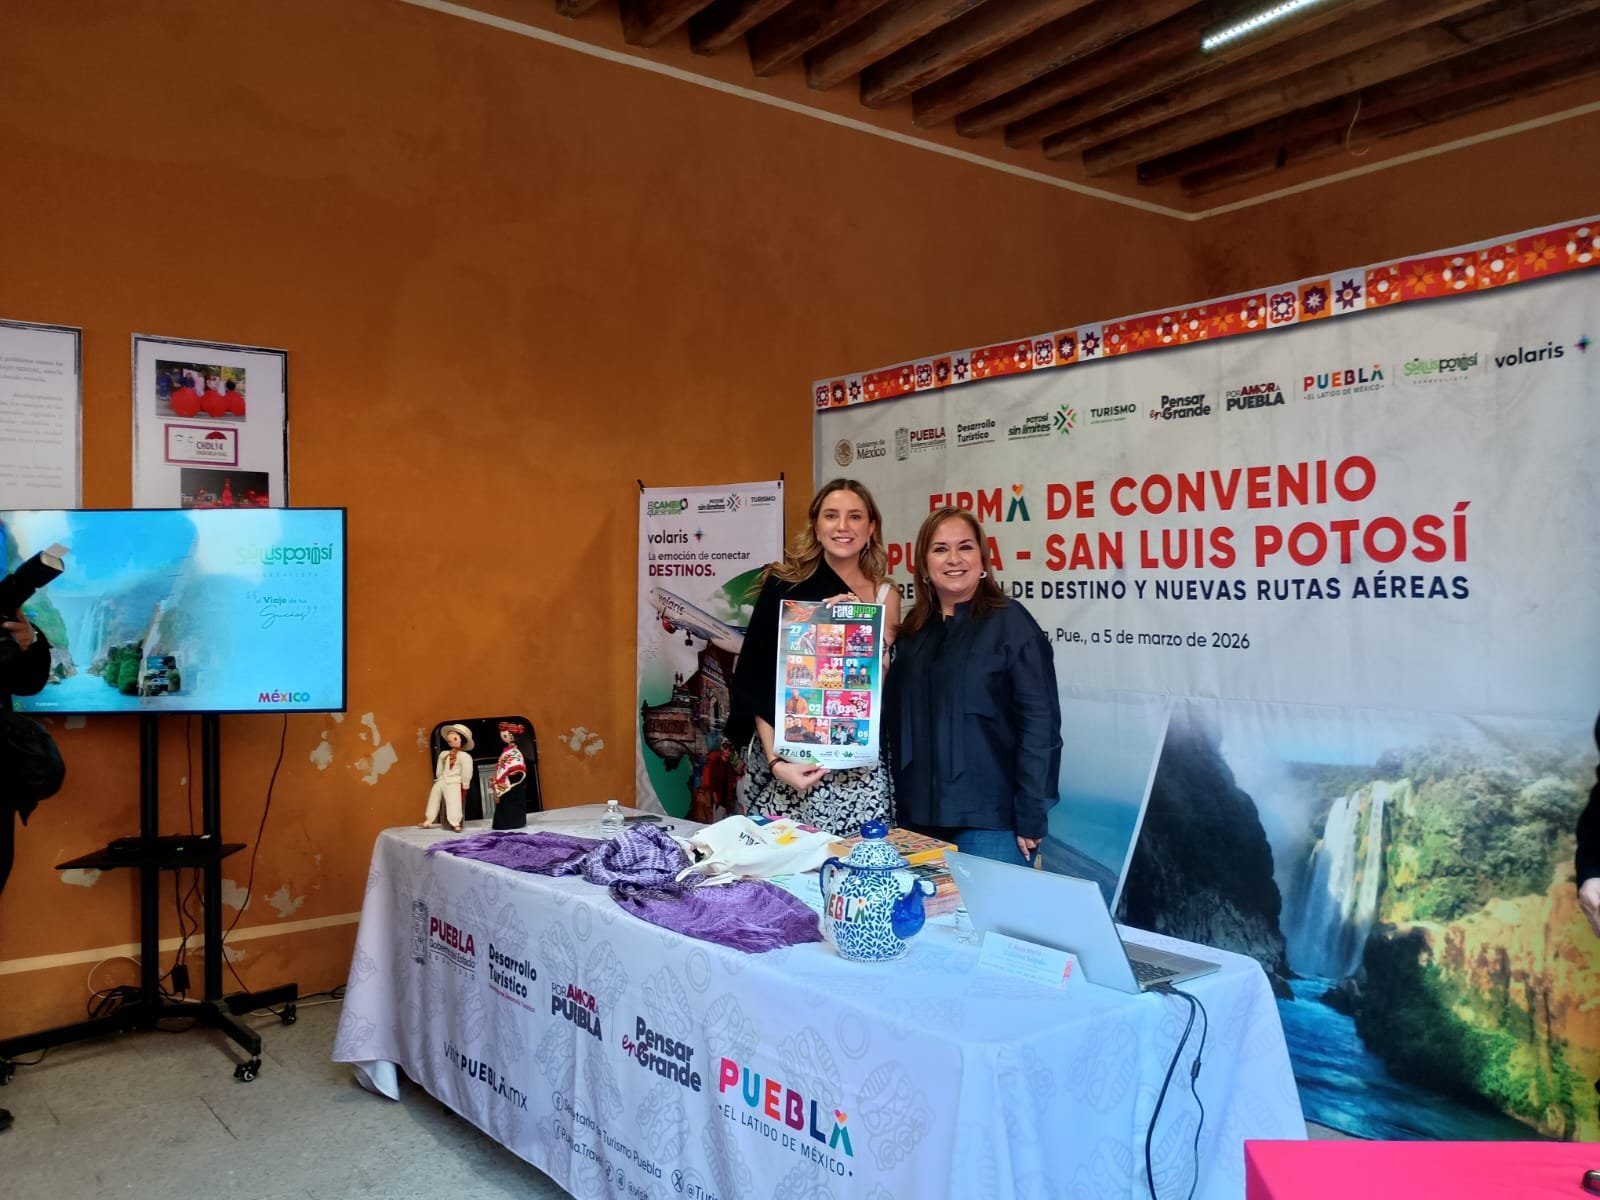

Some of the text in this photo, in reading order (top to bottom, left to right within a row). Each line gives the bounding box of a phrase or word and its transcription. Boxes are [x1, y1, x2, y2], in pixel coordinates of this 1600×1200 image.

[1495, 342, 1564, 368] volaris
[1303, 364, 1384, 391] PUEBLA
[1090, 403, 1136, 418] TURISMO
[1161, 394, 1205, 409] Pensar
[1226, 392, 1285, 411] PUEBLA
[1162, 404, 1211, 420] Grande
[910, 427, 946, 442] PUEBLA
[957, 419, 996, 433] Desarrollo
[856, 446, 886, 460] México
[1047, 481, 1095, 520] DE
[1110, 455, 1376, 517] CONVENIO
[648, 530, 688, 544] volaris
[888, 536, 1003, 575] PUA
[1045, 531, 1123, 571] SAN
[1140, 526, 1236, 570] LUIS
[1255, 501, 1471, 567] POTOSÍ
[648, 551, 750, 561] La emoción de conectar
[649, 564, 715, 577] DESTINOS.
[1012, 581, 1033, 599] DE
[1041, 580, 1126, 599] DESTINO
[1134, 580, 1147, 599] Y
[1156, 580, 1246, 600] NUEVAS
[1257, 577, 1341, 600] RUTAS
[1352, 570, 1469, 600] AÉREAS
[790, 625, 802, 634] 27
[859, 625, 872, 634] 29
[1056, 628, 1087, 645] Pue.,
[1091, 632, 1100, 643] a
[1104, 629, 1112, 644] 5
[1116, 629, 1134, 644] de
[1138, 633, 1182, 647] marzo
[1186, 632, 1207, 647] de
[1212, 632, 1250, 650] 2026
[809, 704, 850, 714] 02 03
[780, 748, 790, 756] 27
[800, 750, 812, 758] 05
[430, 916, 475, 957] PUEBLA
[489, 943, 537, 981] Desarrollo
[552, 982, 567, 998] POR
[636, 1016, 694, 1062] Pensar
[622, 1034, 702, 1092] en Grande
[719, 1057, 854, 1157] PUEBLA
[724, 1104, 845, 1177] EL LATIDO DE MÉXICO
[633, 1151, 662, 1179] Puebla
